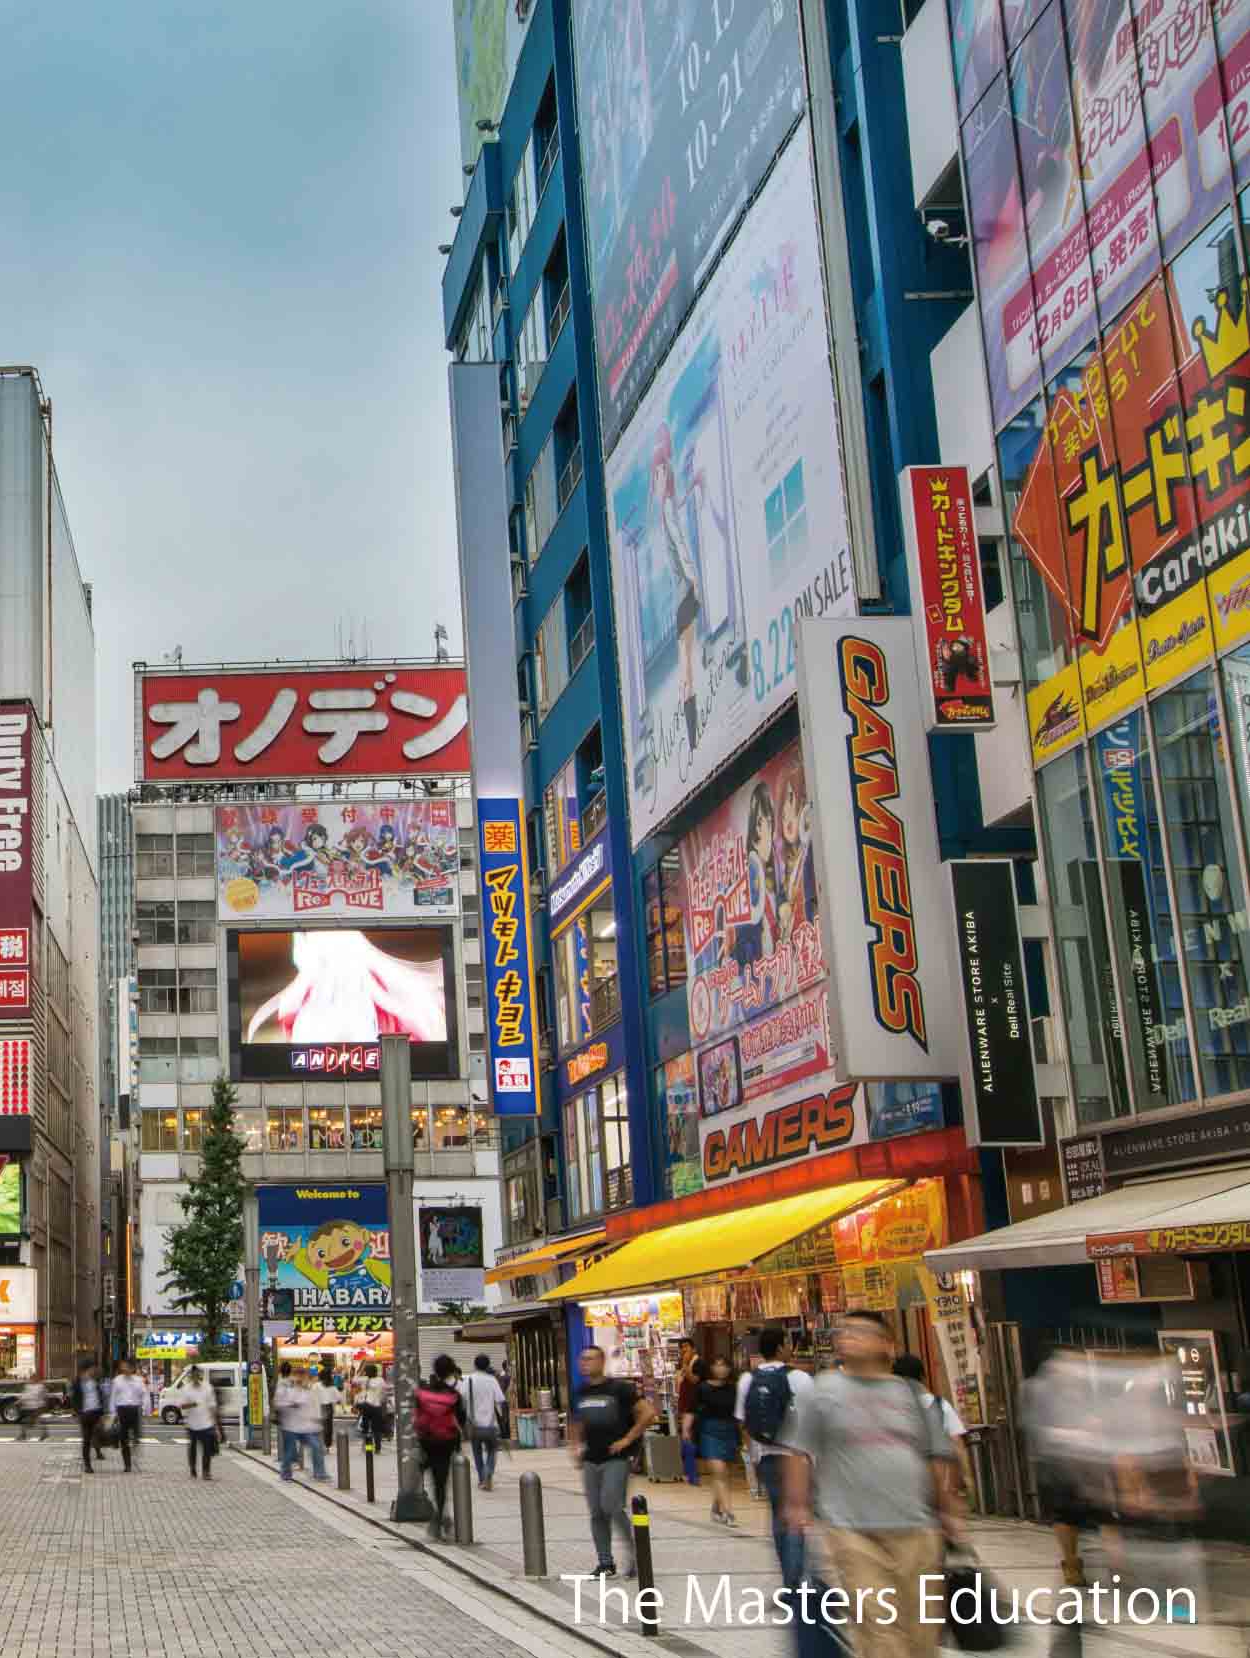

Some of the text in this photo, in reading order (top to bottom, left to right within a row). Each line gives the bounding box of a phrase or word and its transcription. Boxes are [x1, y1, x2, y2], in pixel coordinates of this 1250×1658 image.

[148, 671, 468, 766] オノデン
[484, 820, 516, 852] 薬
[836, 633, 930, 1055] GAMERS
[965, 911, 994, 1092] ALIENWARE STORE AKIBA
[1003, 962, 1020, 1039] Dell Real Site
[293, 1047, 379, 1074] ANIPLE
[702, 1081, 859, 1183] GAMERS
[296, 1189, 361, 1200] Welcome to
[294, 1288, 392, 1305] IHABAR
